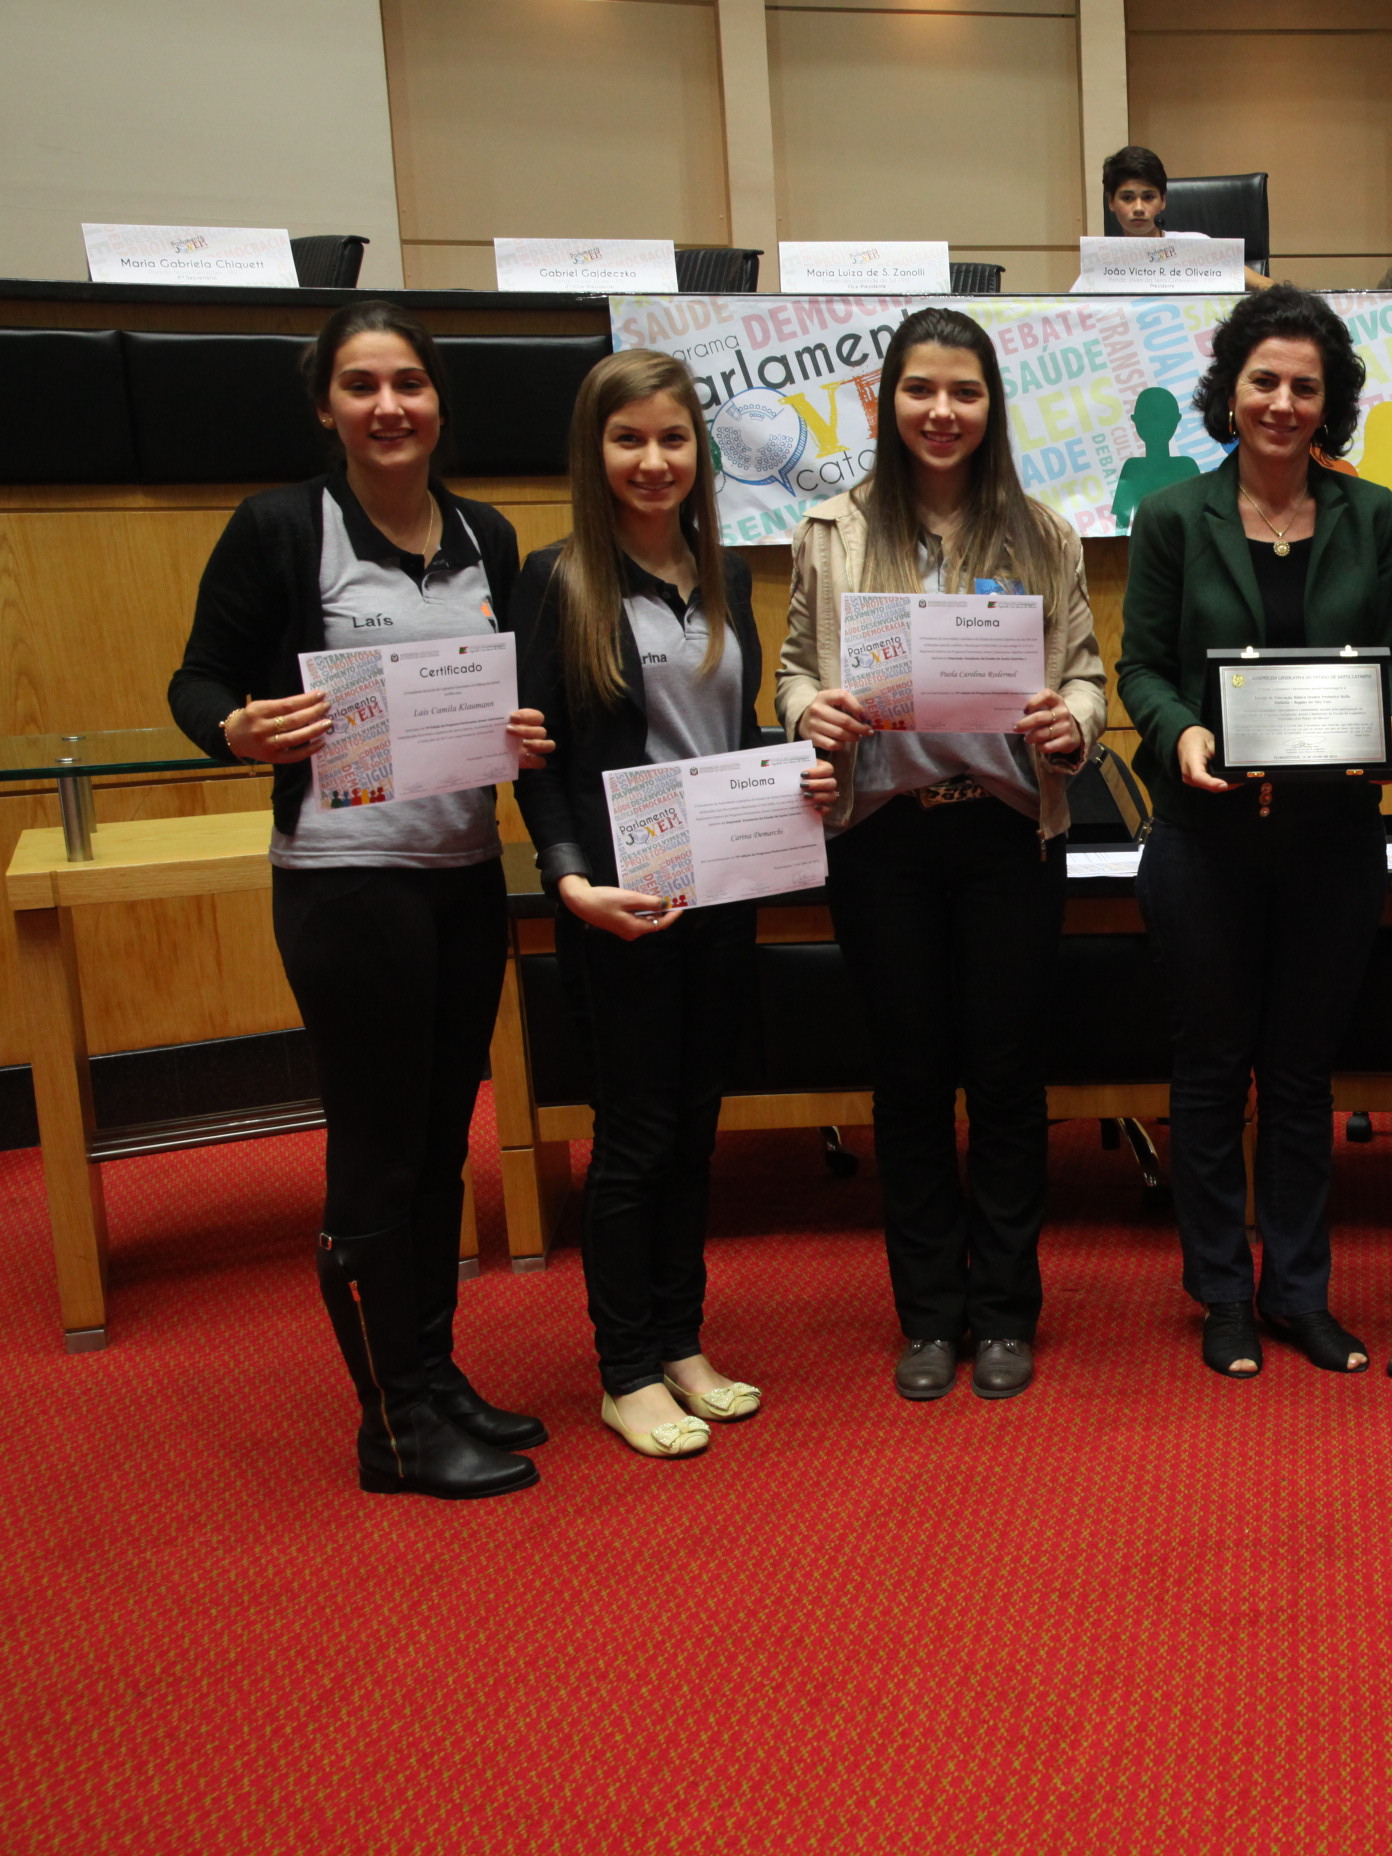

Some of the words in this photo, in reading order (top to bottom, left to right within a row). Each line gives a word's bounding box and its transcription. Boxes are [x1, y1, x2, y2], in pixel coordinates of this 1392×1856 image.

[120, 258, 156, 269] Maria
[159, 259, 212, 269] Gabriela
[215, 260, 264, 270] Chiquett
[1103, 266, 1126, 277] João
[1128, 267, 1156, 277] Victor
[1160, 267, 1167, 277] R.
[1170, 267, 1182, 277] de
[1185, 267, 1222, 277] Oliveira
[539, 268, 578, 278] Gabriel
[806, 268, 835, 278] Maria
[838, 268, 863, 278] Luiza
[866, 268, 879, 278] de
[882, 268, 890, 278] S.
[1009, 377, 1124, 453] LEIS
[352, 613, 394, 630] Laís
[956, 616, 1000, 628] Diploma
[847, 636, 902, 657] Parlamento
[420, 662, 483, 678] Certificado
[730, 776, 775, 790] Diploma
[633, 791, 679, 815] DEMOCRACIA
[619, 807, 676, 835] Parlamento
